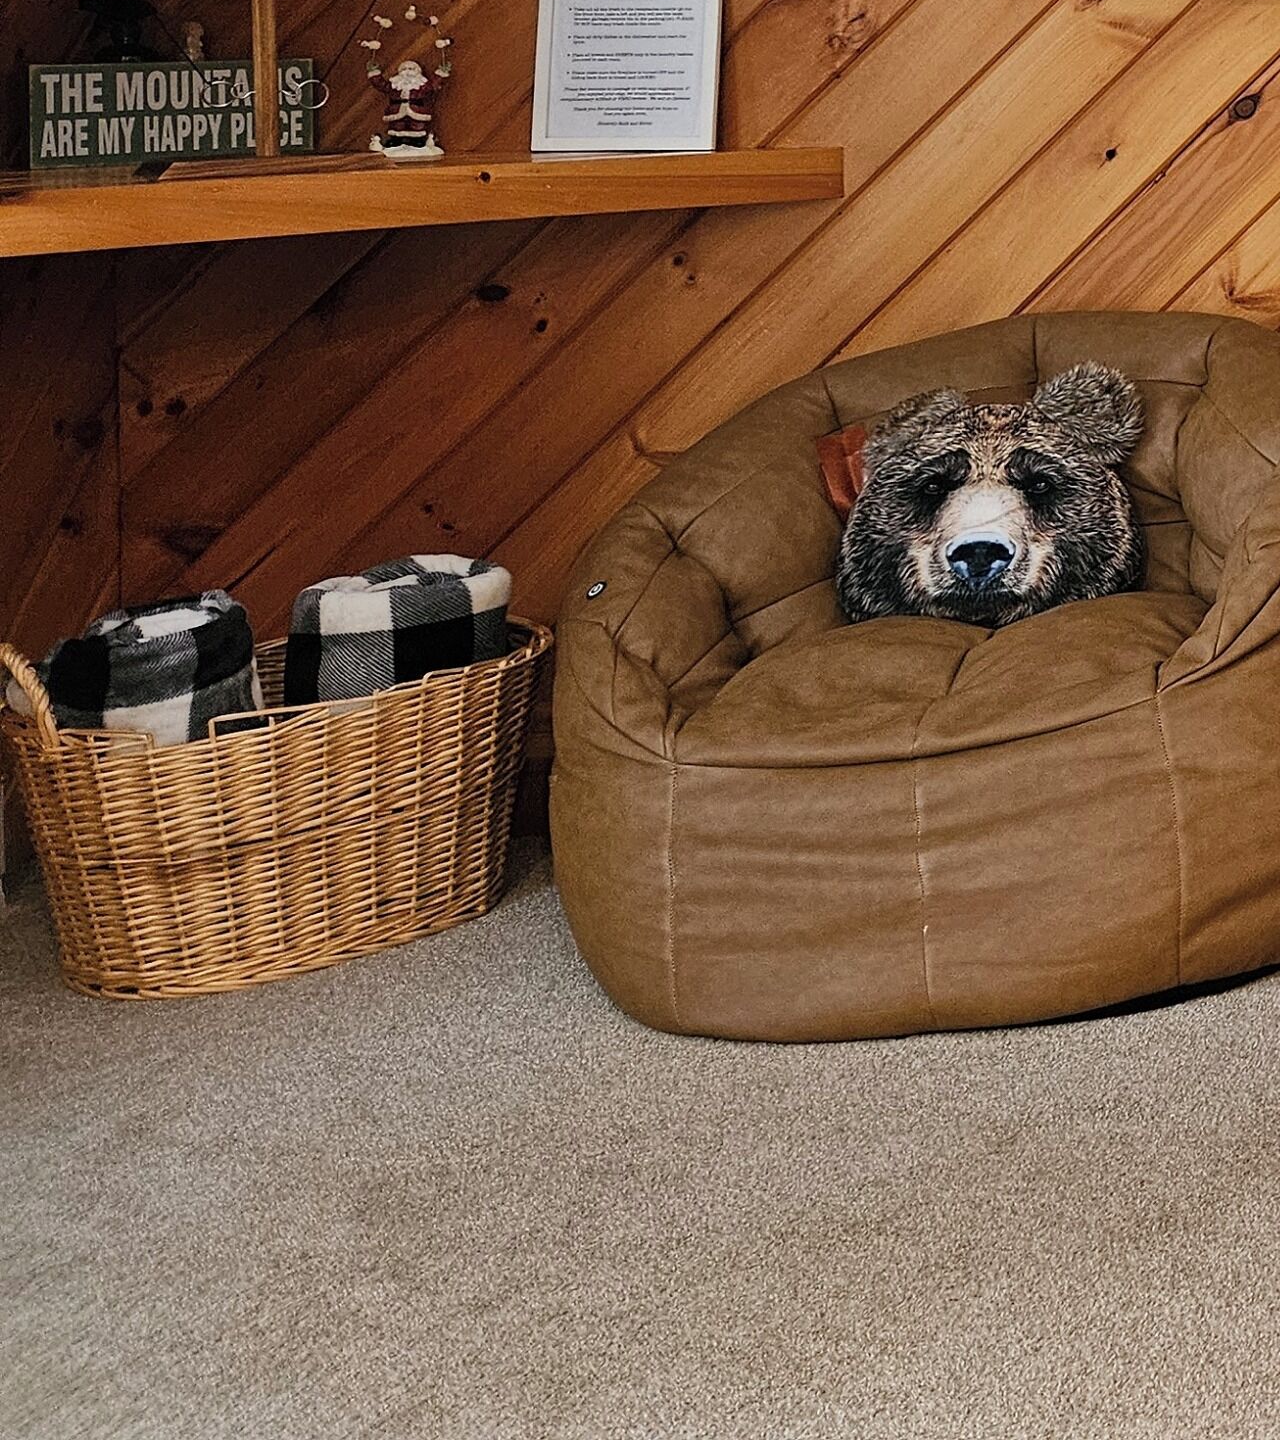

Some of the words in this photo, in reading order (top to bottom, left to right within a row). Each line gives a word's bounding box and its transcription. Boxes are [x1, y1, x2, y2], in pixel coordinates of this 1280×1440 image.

[40, 72, 103, 114] THE
[115, 66, 303, 111] MOUNTAS
[40, 118, 89, 158] ARE
[98, 116, 135, 155] MY
[143, 113, 223, 153] HAPPY
[230, 110, 304, 149] PLCE
